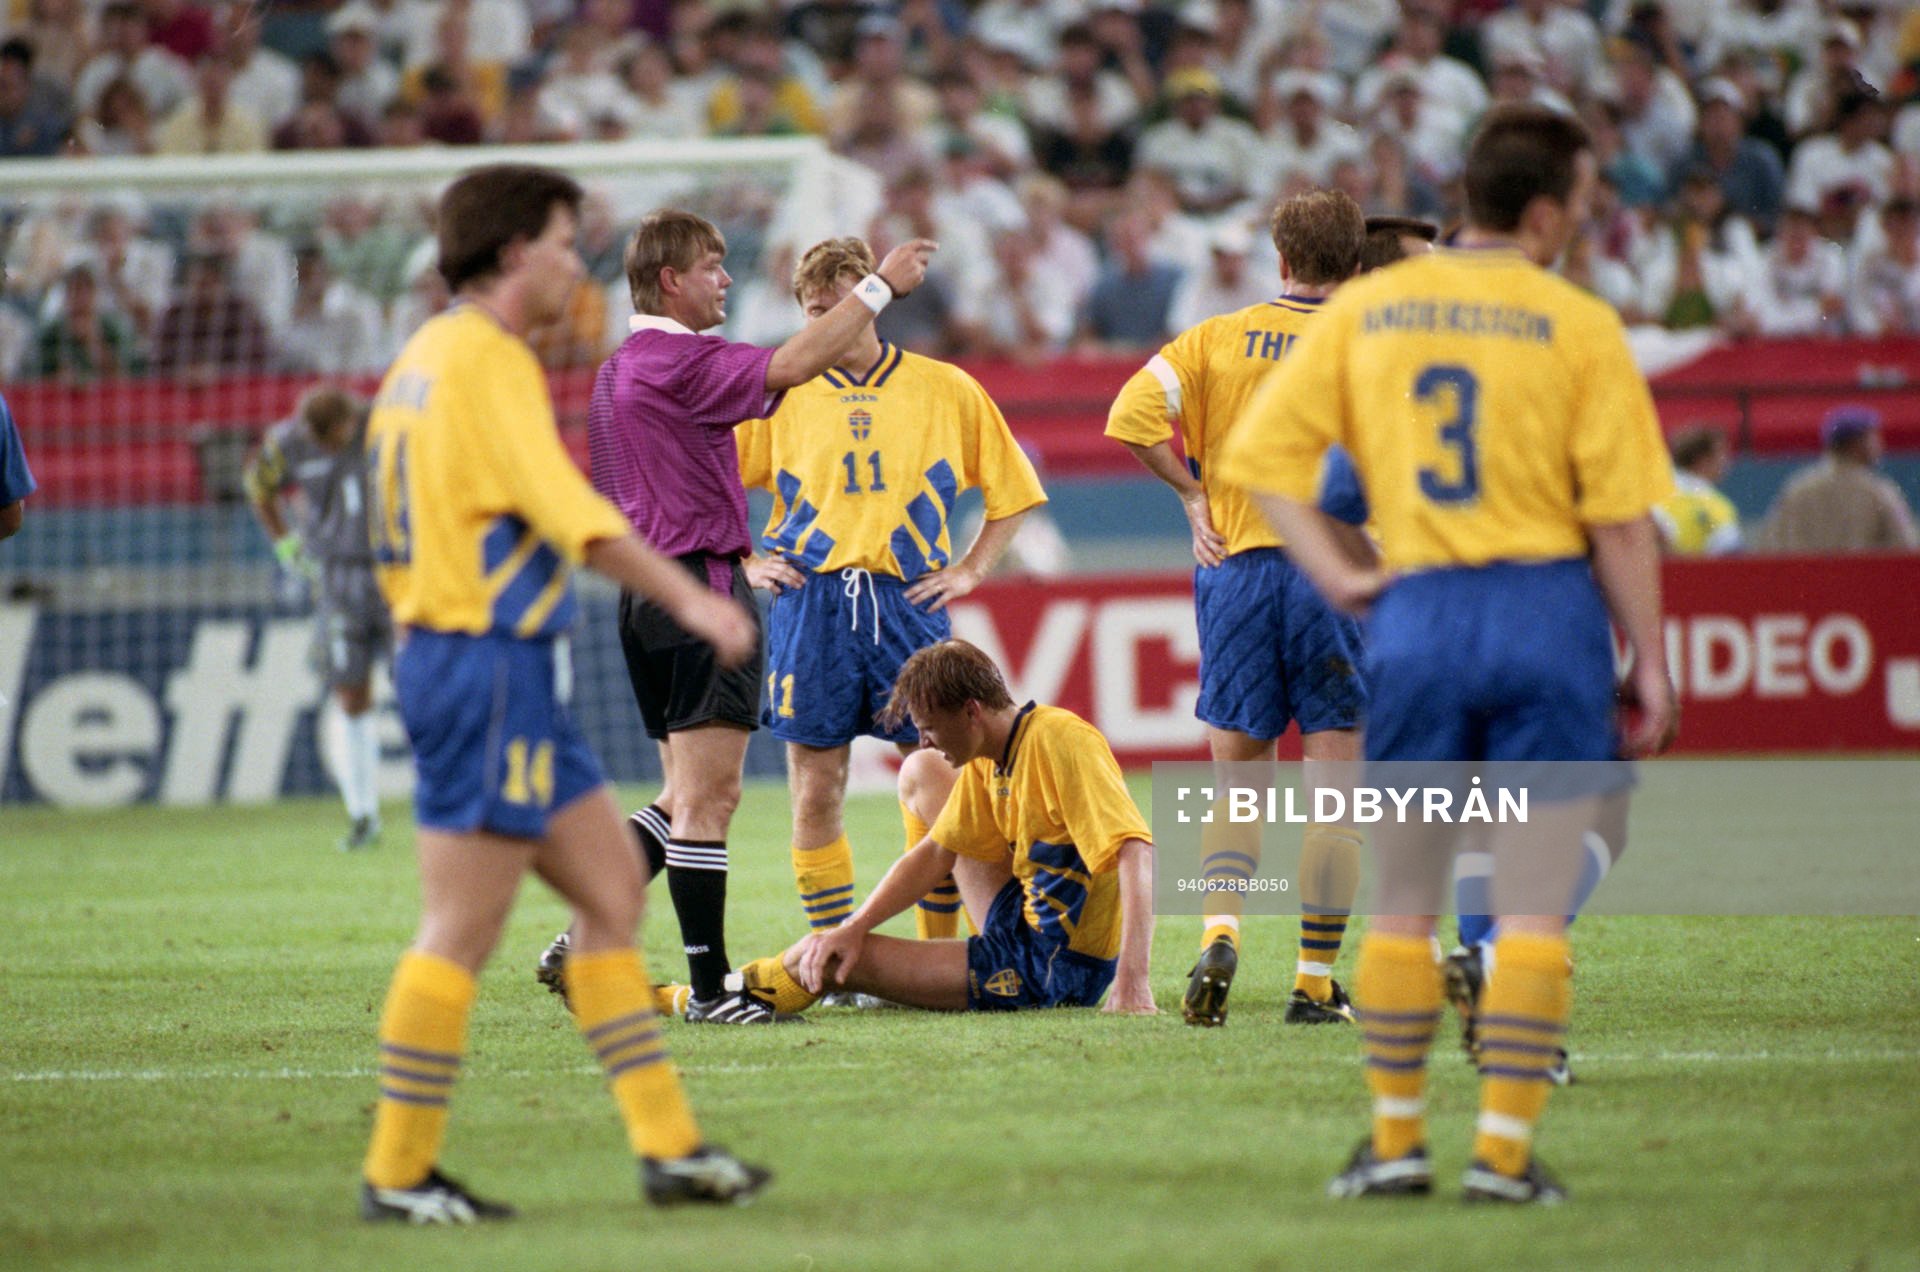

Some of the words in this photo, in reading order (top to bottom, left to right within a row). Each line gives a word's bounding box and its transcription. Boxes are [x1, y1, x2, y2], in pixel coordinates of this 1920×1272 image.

[841, 393, 877, 403] adidas
[1414, 364, 1480, 508] 3
[842, 451, 886, 494] 11
